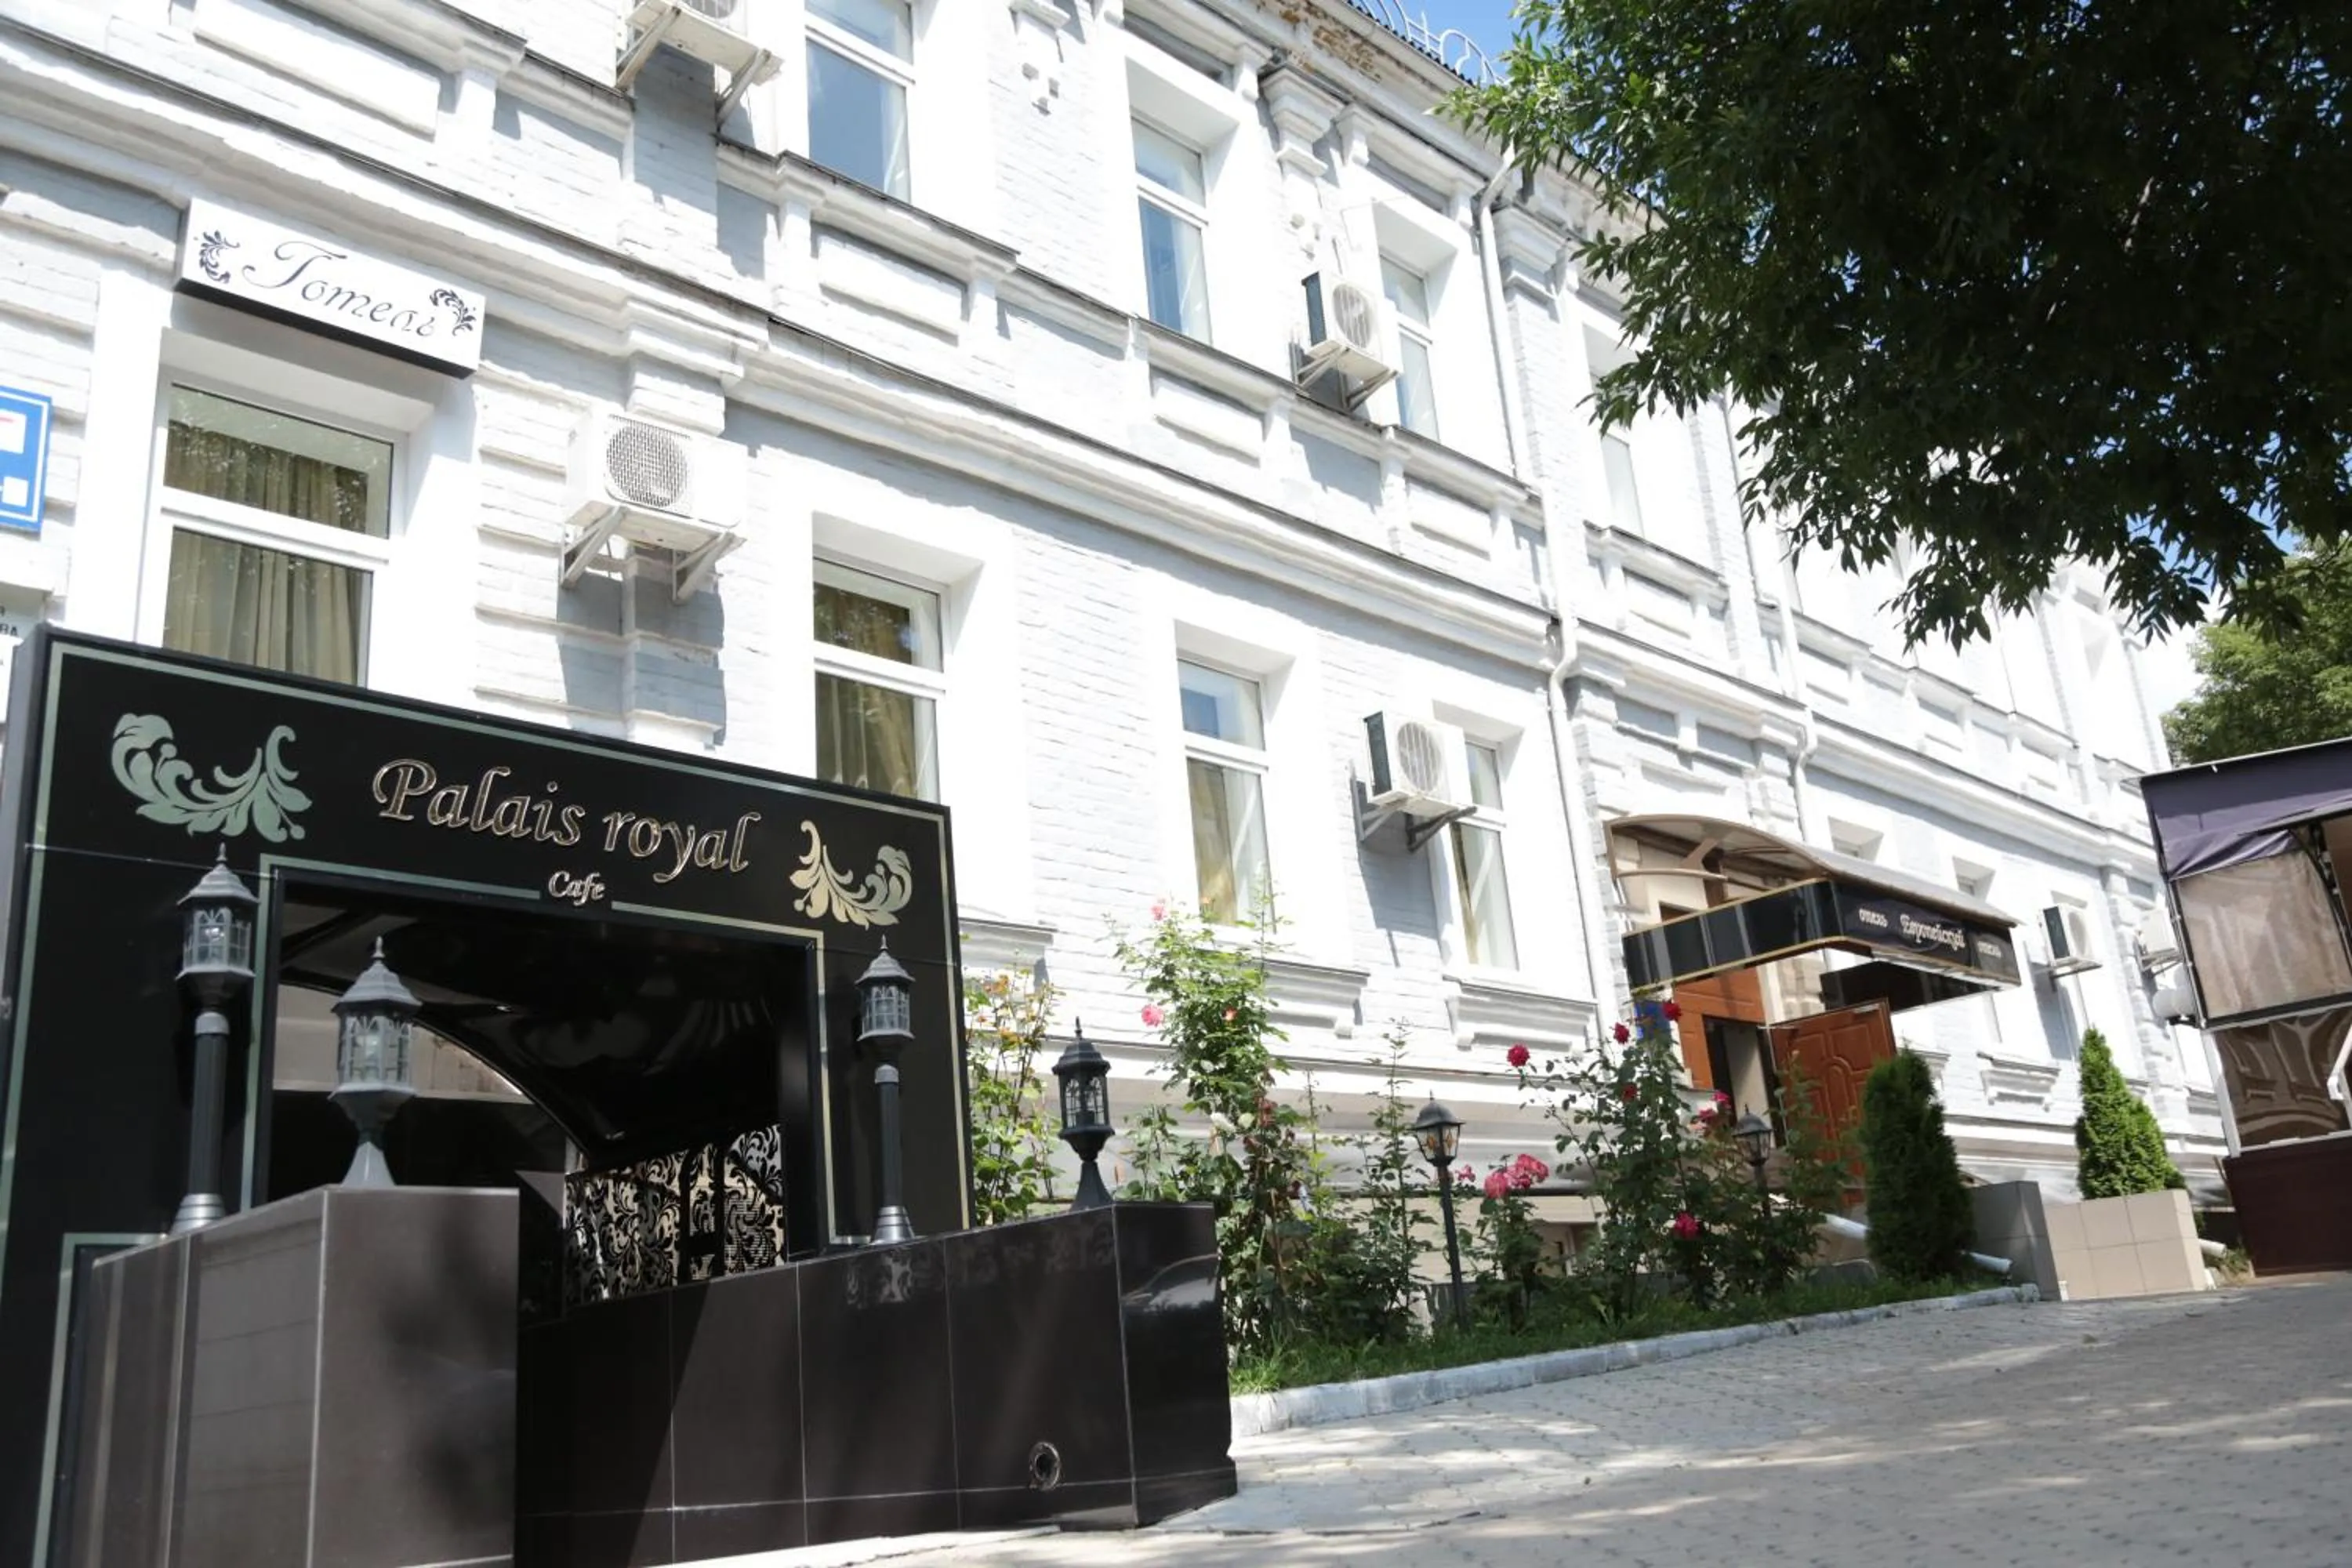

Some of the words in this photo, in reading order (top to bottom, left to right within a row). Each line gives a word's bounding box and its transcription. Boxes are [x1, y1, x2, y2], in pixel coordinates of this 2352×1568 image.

[372, 758, 586, 846] Palais
[602, 811, 761, 883] royal
[549, 870, 605, 906] Cafe
